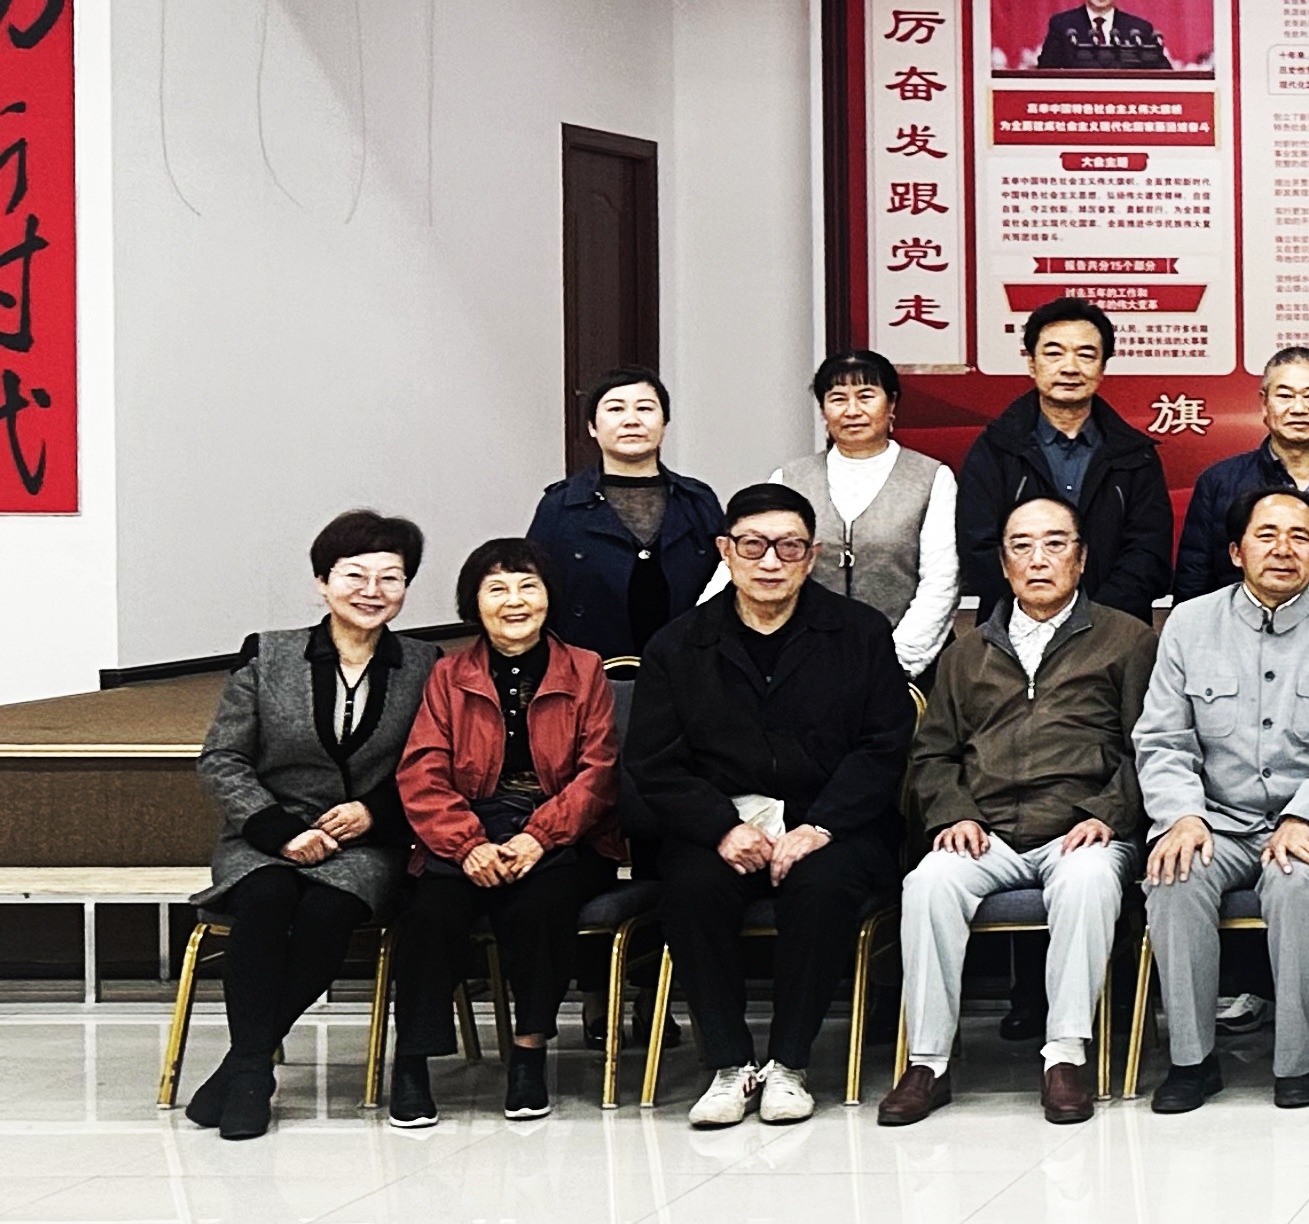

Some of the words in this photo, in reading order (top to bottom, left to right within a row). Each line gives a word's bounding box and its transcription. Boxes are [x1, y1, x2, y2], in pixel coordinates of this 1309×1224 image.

[884, 9, 950, 330] 厉奋发跟党走
[1081, 156, 1129, 168] 大会主题
[1148, 394, 1211, 435] 旗
